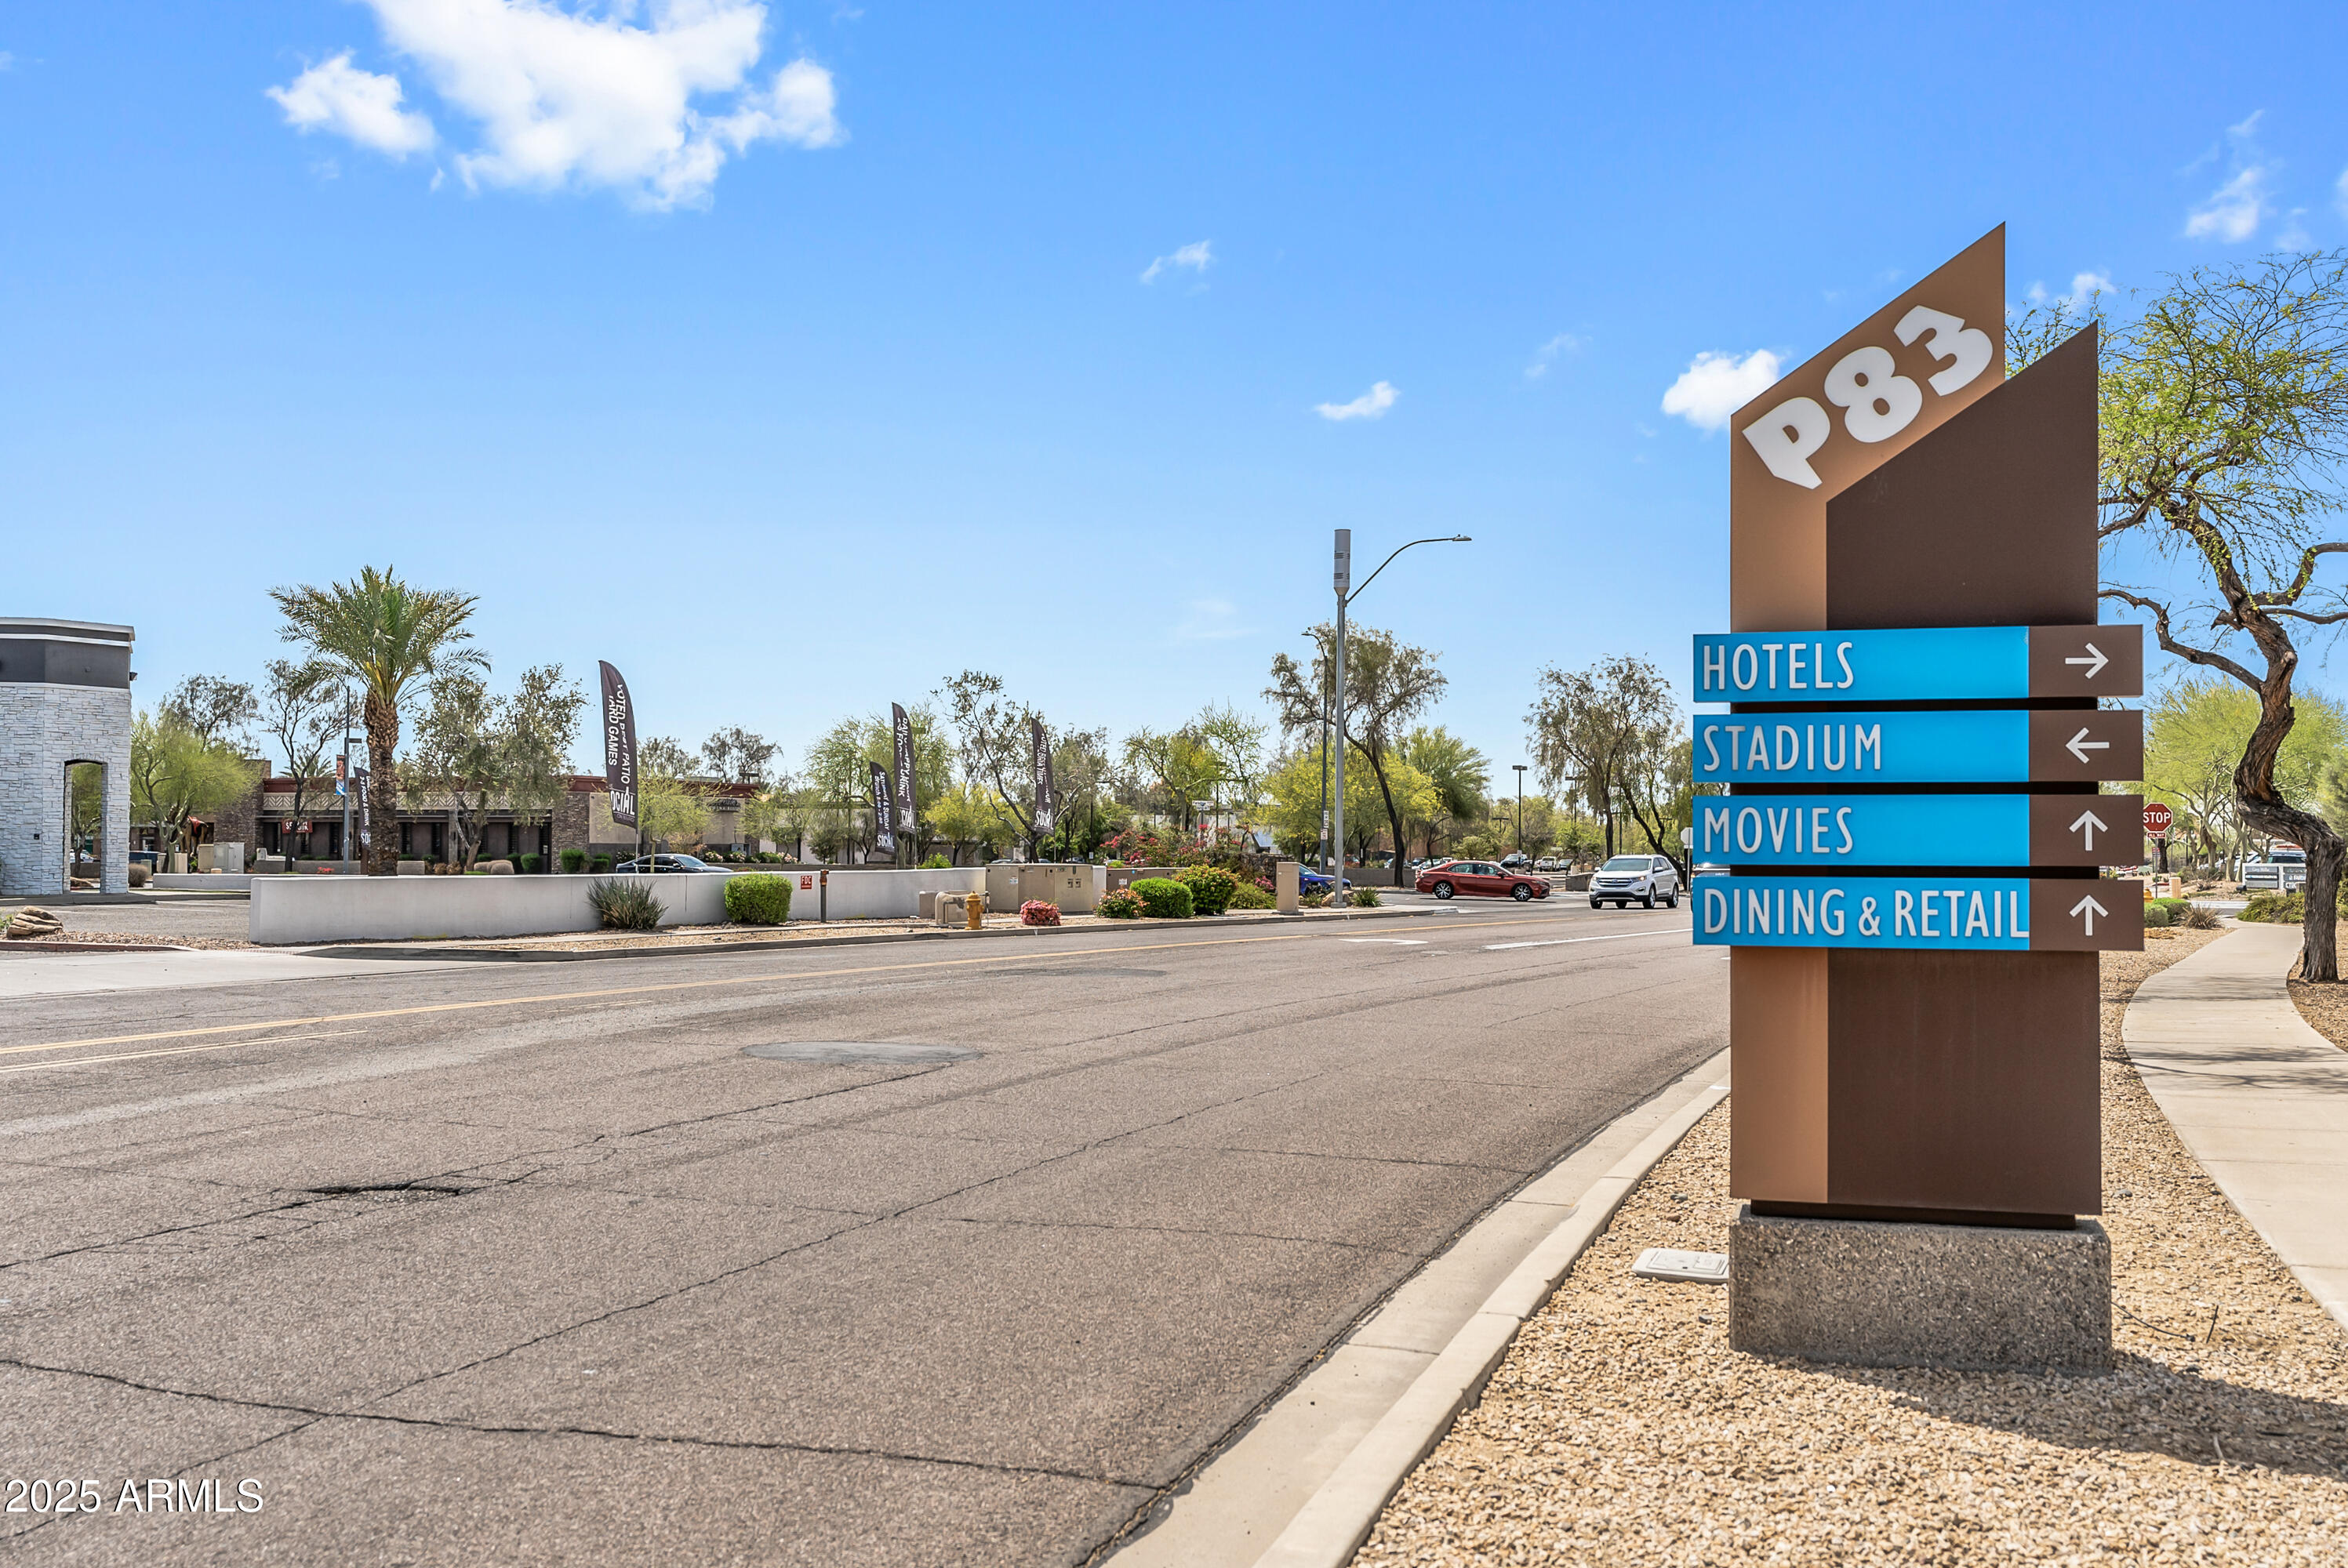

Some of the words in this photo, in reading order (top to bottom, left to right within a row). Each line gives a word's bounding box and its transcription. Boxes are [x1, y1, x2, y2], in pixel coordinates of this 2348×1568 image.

[1742, 304, 1994, 490] P83
[1703, 641, 1854, 691] HOTELS
[608, 726, 618, 766] GAMES
[620, 752, 631, 785] PATIO
[1703, 724, 1881, 771] STADIUM
[1704, 806, 1854, 854] MOVIES
[2143, 811, 2171, 824] STOP
[801, 876, 812, 884] FDC
[1704, 887, 1845, 936] DINING
[1859, 896, 1881, 937] &
[1894, 889, 2030, 938] RETAIL
